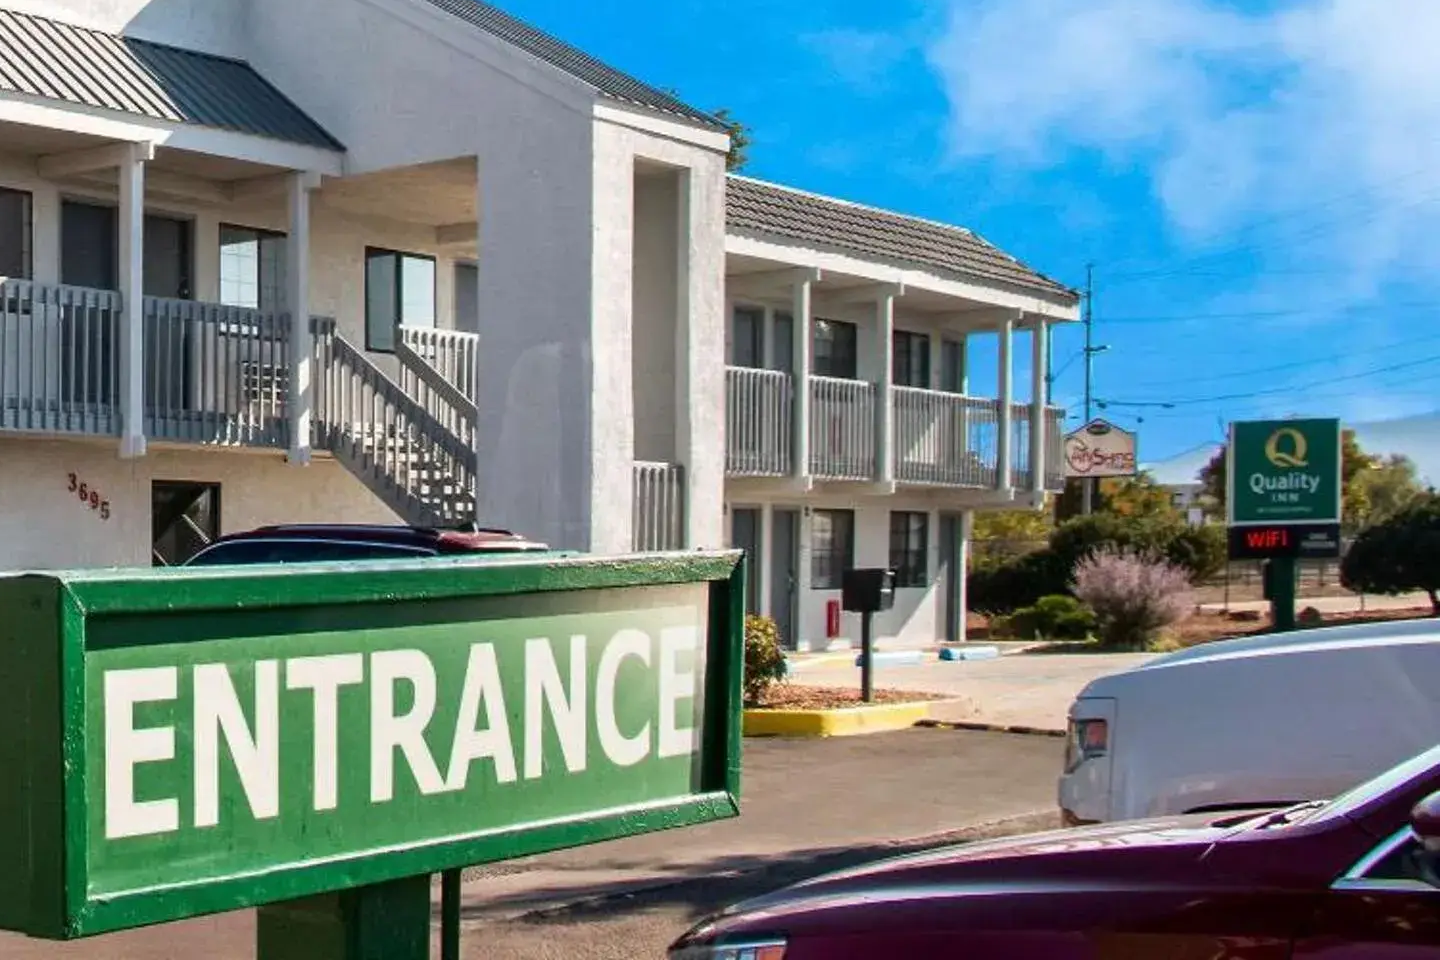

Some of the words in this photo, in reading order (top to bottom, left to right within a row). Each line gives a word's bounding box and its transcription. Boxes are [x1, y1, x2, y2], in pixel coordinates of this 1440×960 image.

[1264, 428, 1309, 468] Q
[68, 472, 110, 520] 3695
[1249, 472, 1320, 494] Quality
[102, 624, 700, 840] ENTRANCE
